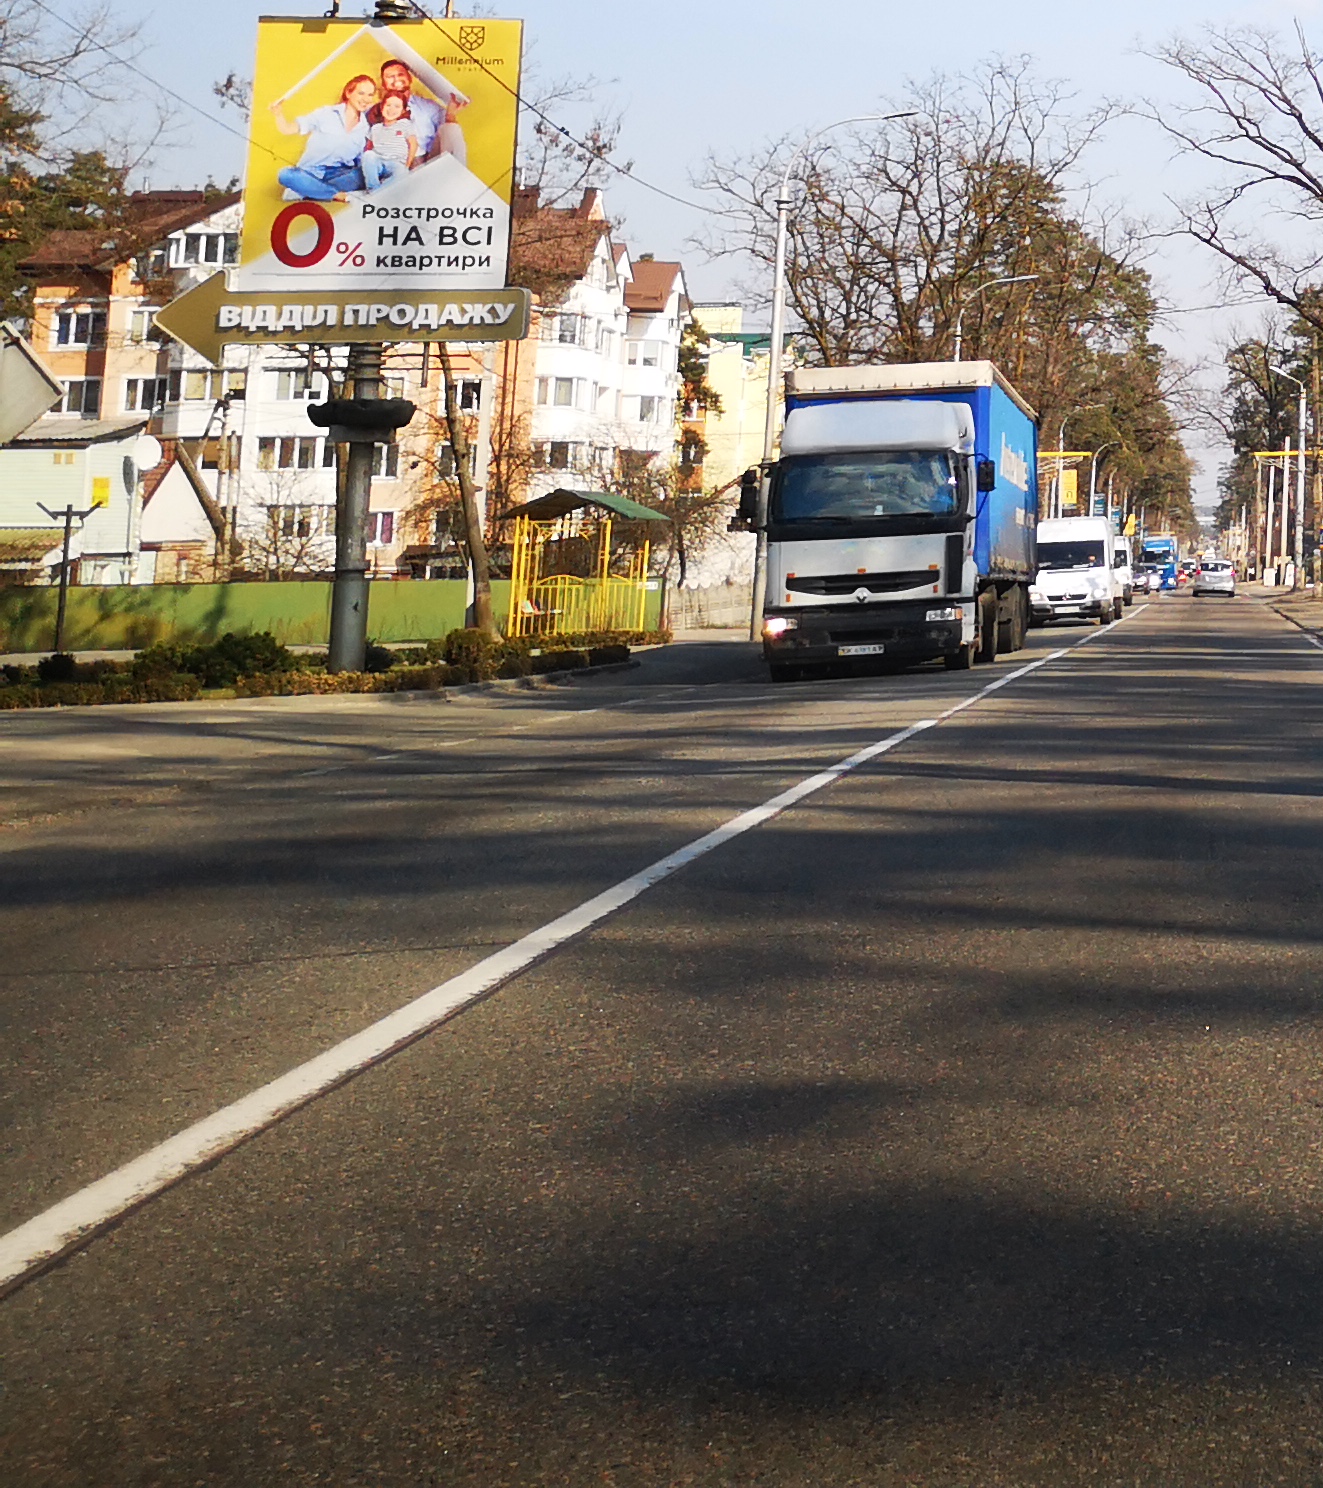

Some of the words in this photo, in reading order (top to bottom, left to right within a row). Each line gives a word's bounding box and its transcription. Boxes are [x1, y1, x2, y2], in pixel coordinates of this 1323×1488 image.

[361, 204, 495, 222] Розстрочка
[377, 226, 426, 246] НА
[438, 225, 494, 246] ВСІ
[375, 253, 491, 271] квартири
[218, 304, 338, 331] ВІДДІЛ
[343, 303, 516, 330] ПРОДАЖУ
